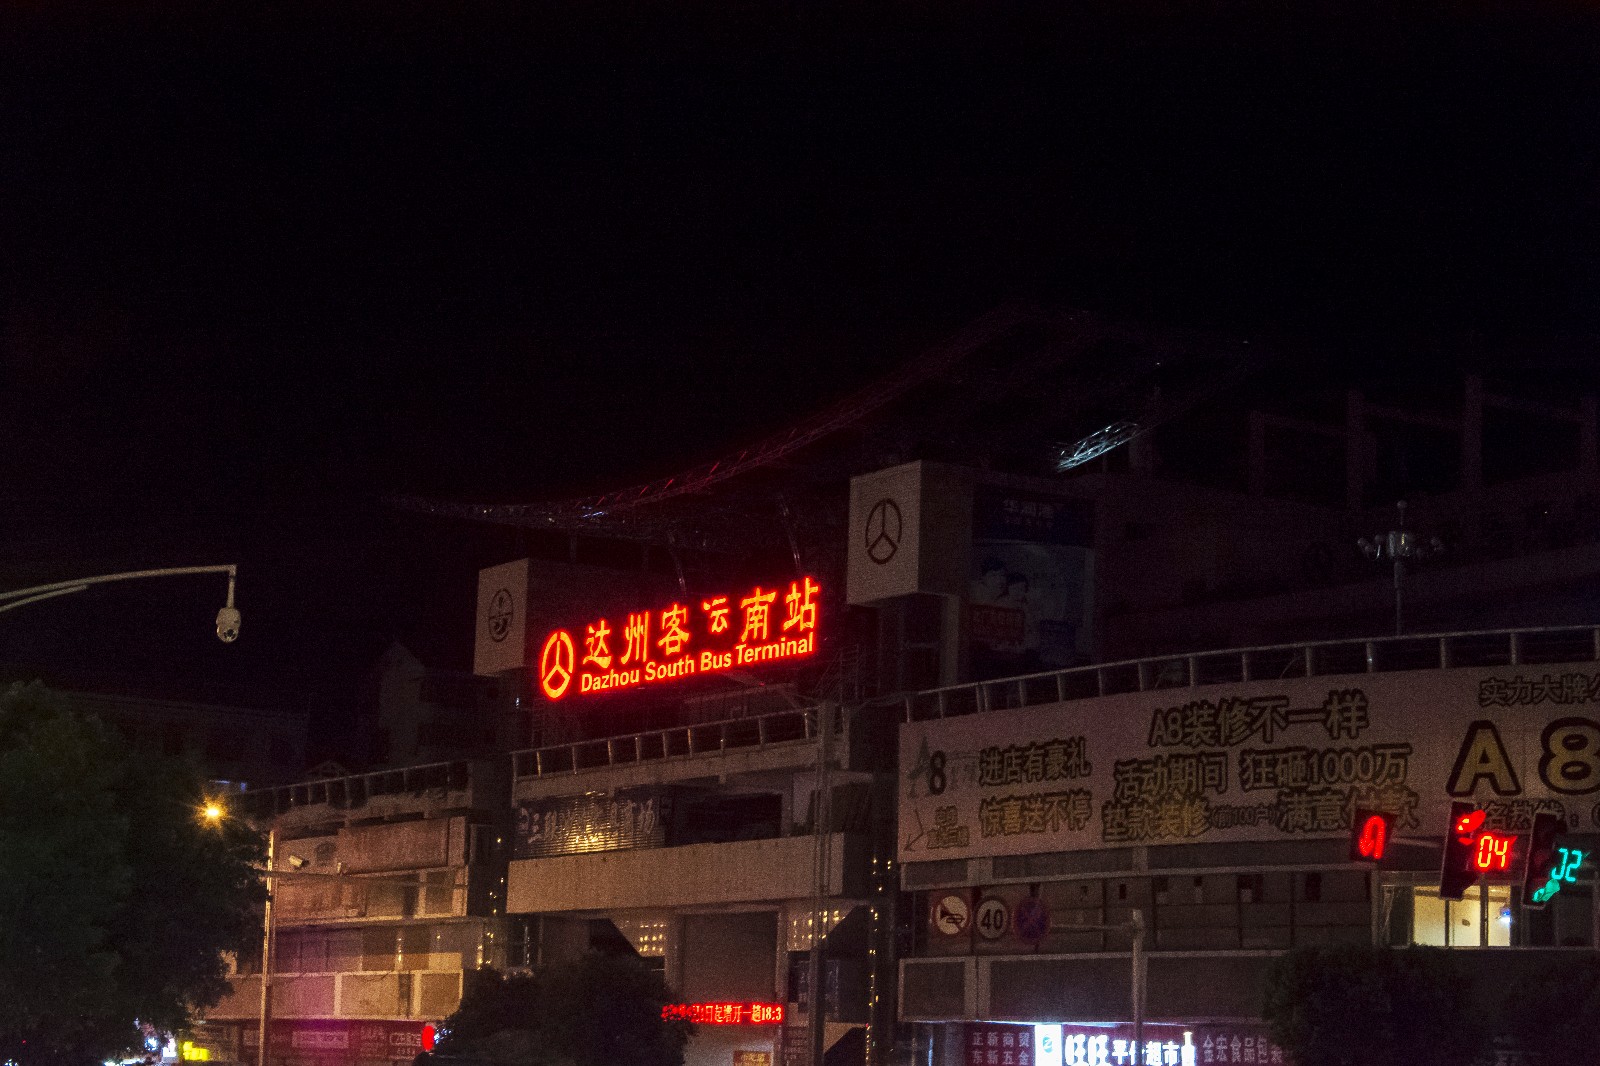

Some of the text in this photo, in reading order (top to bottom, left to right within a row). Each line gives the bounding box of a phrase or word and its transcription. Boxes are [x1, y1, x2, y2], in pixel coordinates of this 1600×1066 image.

[580, 632, 814, 692] Dazhou South Bus Terminal
[1149, 688, 1369, 747] A8装修不一样
[979, 736, 1092, 786] 进店有豪礼
[1113, 742, 1413, 802] 活动期间 狂砸1000万
[979, 788, 1092, 838] 惊喜送不停
[1476, 835, 1509, 868] 04
[980, 908, 1004, 930] 40
